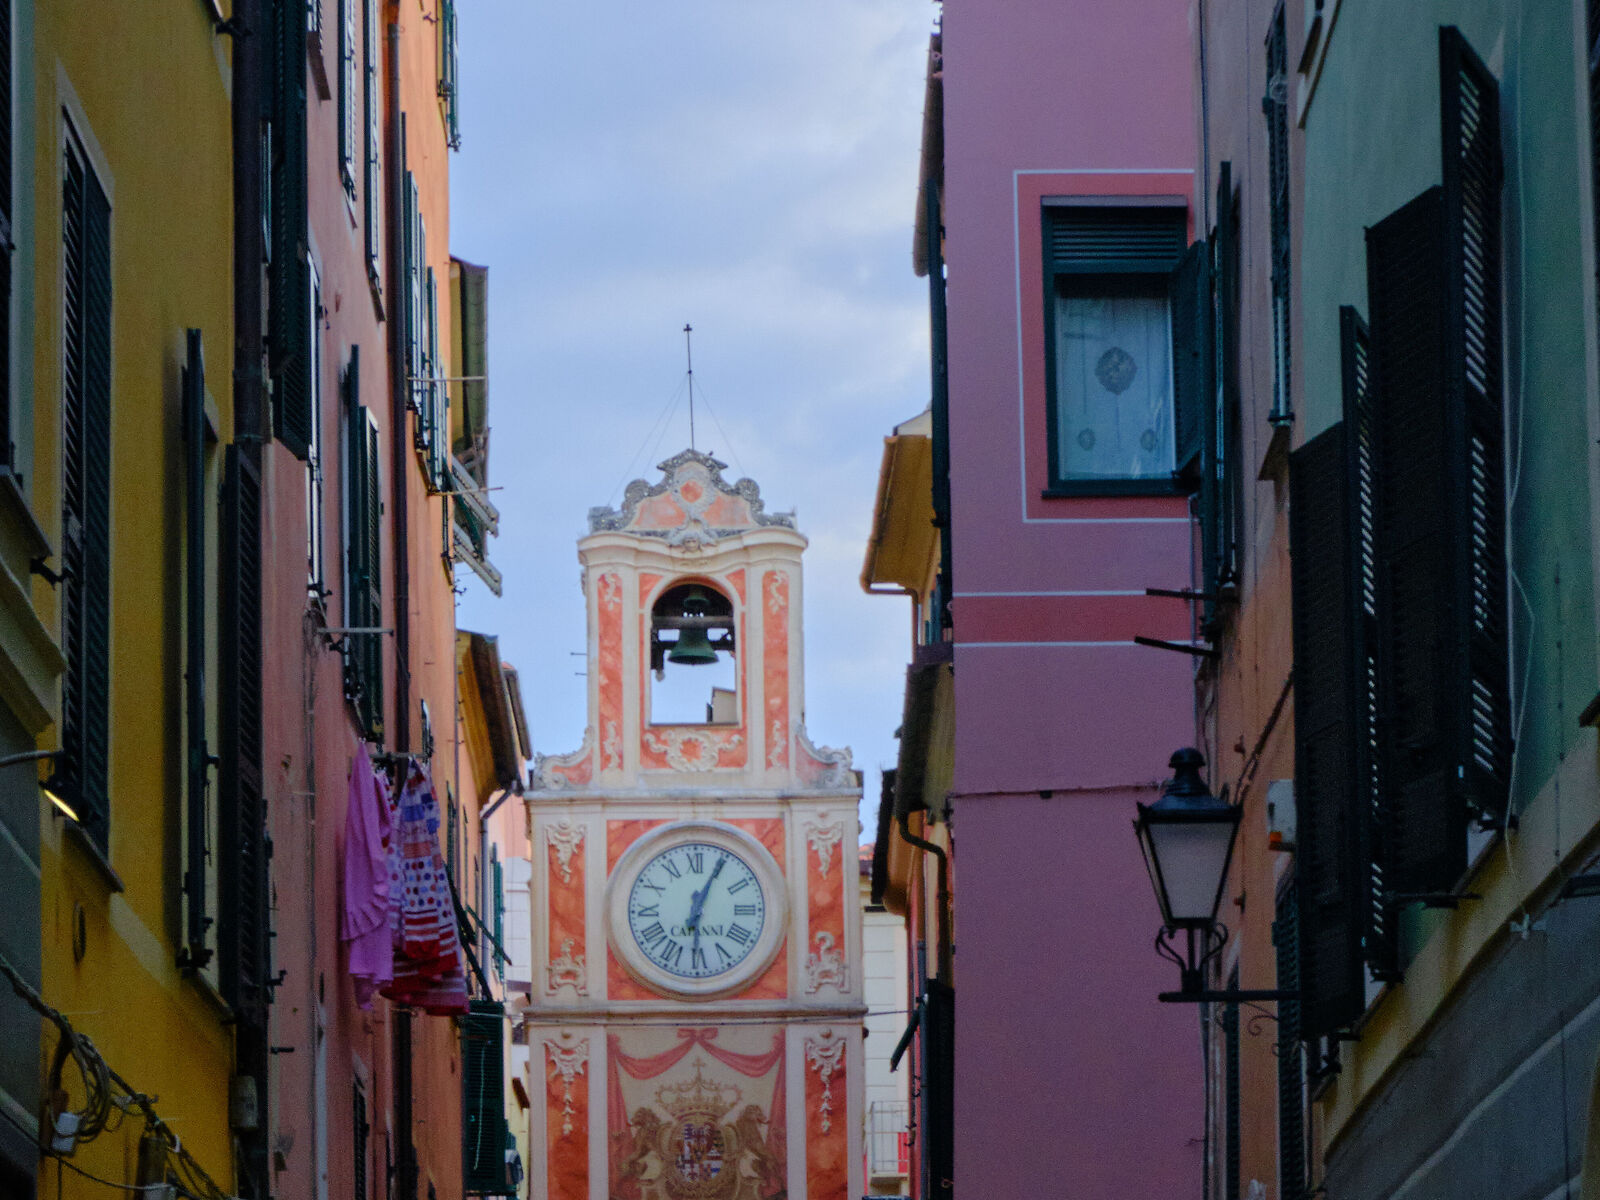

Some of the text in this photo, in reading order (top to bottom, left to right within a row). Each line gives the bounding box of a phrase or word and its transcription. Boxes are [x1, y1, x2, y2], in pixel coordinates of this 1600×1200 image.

[687, 853, 704, 874] XII
[643, 878, 666, 897] X
[728, 878, 749, 895] II
[734, 904, 756, 916] III
[715, 942, 732, 964] V
